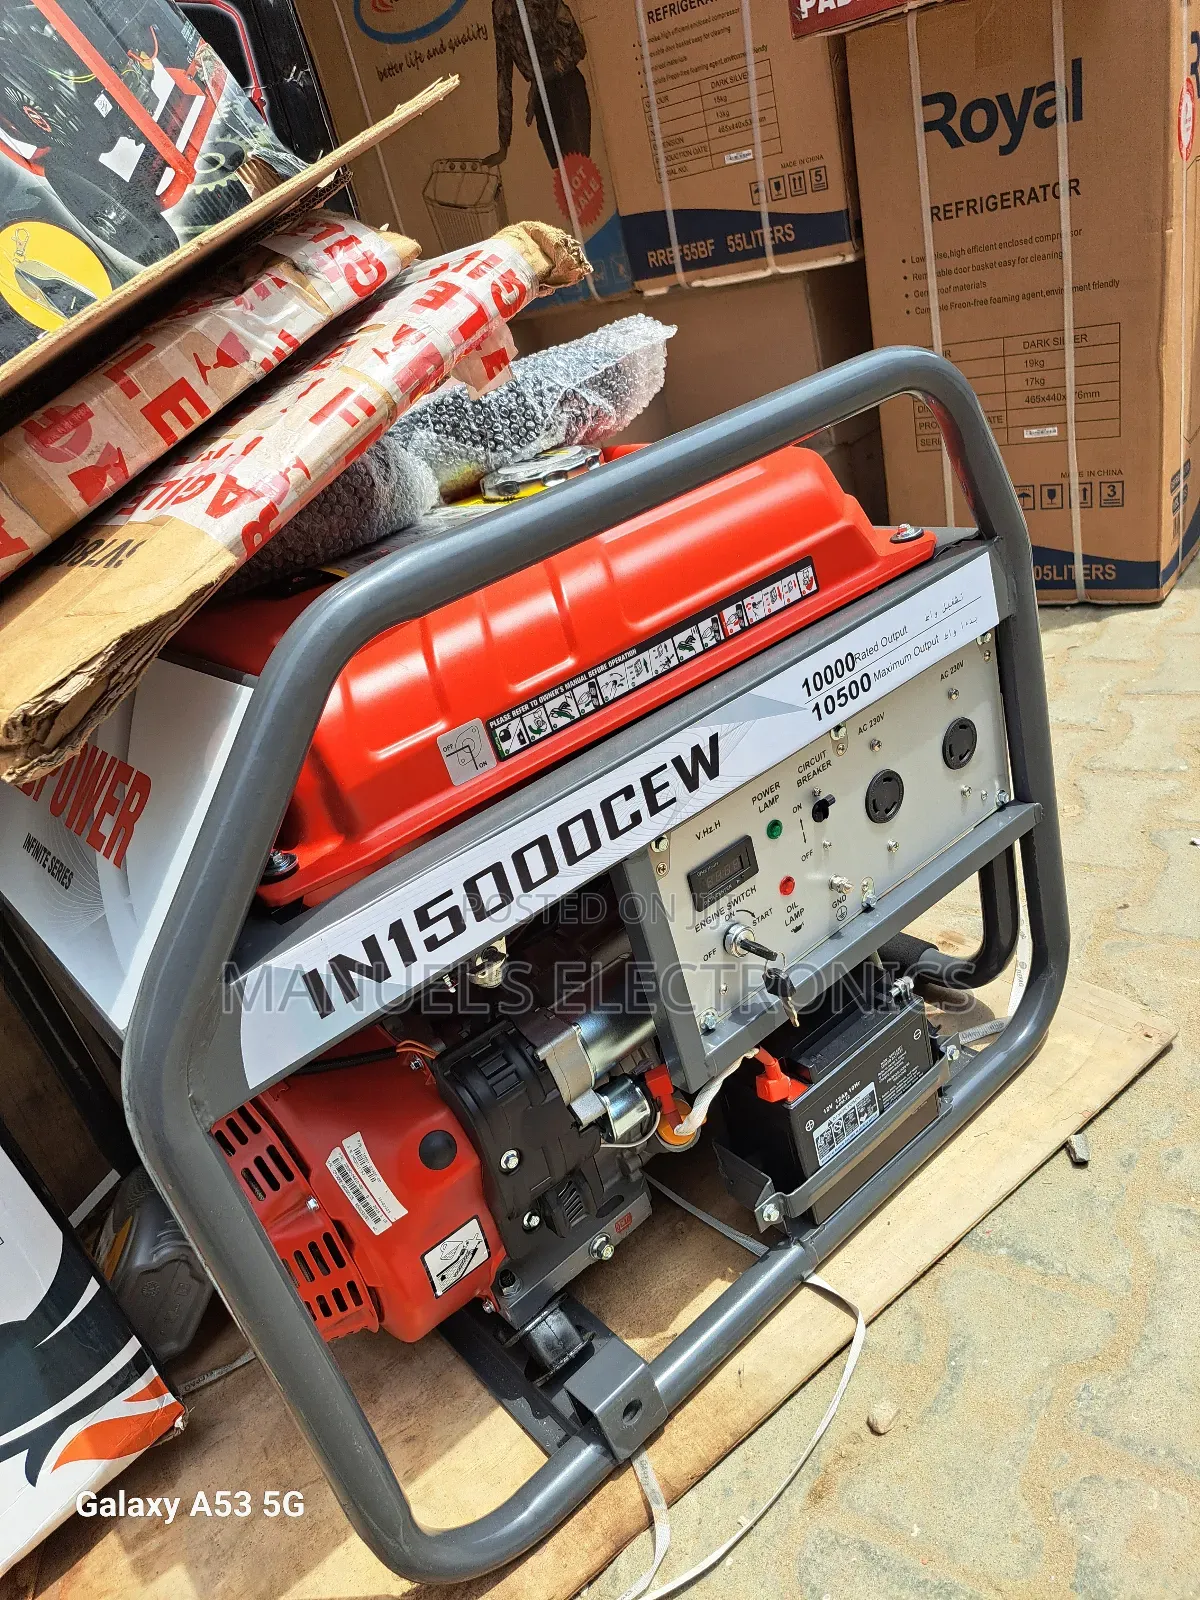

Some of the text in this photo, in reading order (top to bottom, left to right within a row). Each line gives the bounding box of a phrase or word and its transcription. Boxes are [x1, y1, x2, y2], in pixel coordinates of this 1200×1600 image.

[711, 6, 741, 23] compressor
[710, 25, 731, 39] cleaning
[376, 23, 489, 82] better life and quality
[710, 71, 749, 90] DARK SILVE
[922, 57, 1083, 156] Royal
[780, 154, 825, 170] MADE IN CHINA
[930, 178, 1081, 222] REFRIGERATOR
[967, 240, 998, 255] efficient
[998, 234, 1034, 250] enclosed
[953, 264, 971, 276] door
[971, 260, 998, 273] basket
[997, 256, 1017, 269] easy
[1017, 255, 1029, 265] for
[1029, 250, 1063, 264] cleaning
[949, 297, 990, 311] Freon-free
[989, 292, 1021, 306] foaming
[1092, 278, 1121, 292] friendly
[952, 280, 987, 293] materials
[1022, 333, 1089, 350] DARK SILER
[1024, 358, 1046, 369] 19kg
[1024, 377, 1046, 387] 17kg
[1087, 470, 1096, 478] IN
[1097, 468, 1124, 477] CHINA
[1106, 484, 1118, 498] 3
[801, 625, 908, 698] 10000 Rated Output
[940, 658, 965, 682] AC 230V
[811, 634, 940, 722] 10500 Maximum Output
[489, 648, 637, 730] PLEASE REFER TO OWNER'S MANUAL BEFORE OPERATION
[857, 711, 886, 737] AC 230V
[442, 743, 455, 755] OFF
[478, 759, 489, 770] ON
[797, 750, 827, 775] CIRCUIT
[796, 759, 833, 789] BREAKER
[751, 781, 781, 806] POWER
[758, 794, 780, 814] LAMP
[792, 802, 804, 814] ON
[22, 831, 74, 890] INFINITE SERIES
[801, 849, 814, 863] OFF
[302, 732, 720, 1020] IN15000CEW
[694, 906, 726, 934] ENGINE
[726, 885, 757, 911] SWITCH
[786, 901, 799, 914] OIL
[831, 894, 847, 909] GND
[724, 910, 735, 922] ON
[751, 907, 774, 928] START
[784, 907, 805, 927] LAMP
[702, 947, 717, 963] OFF
